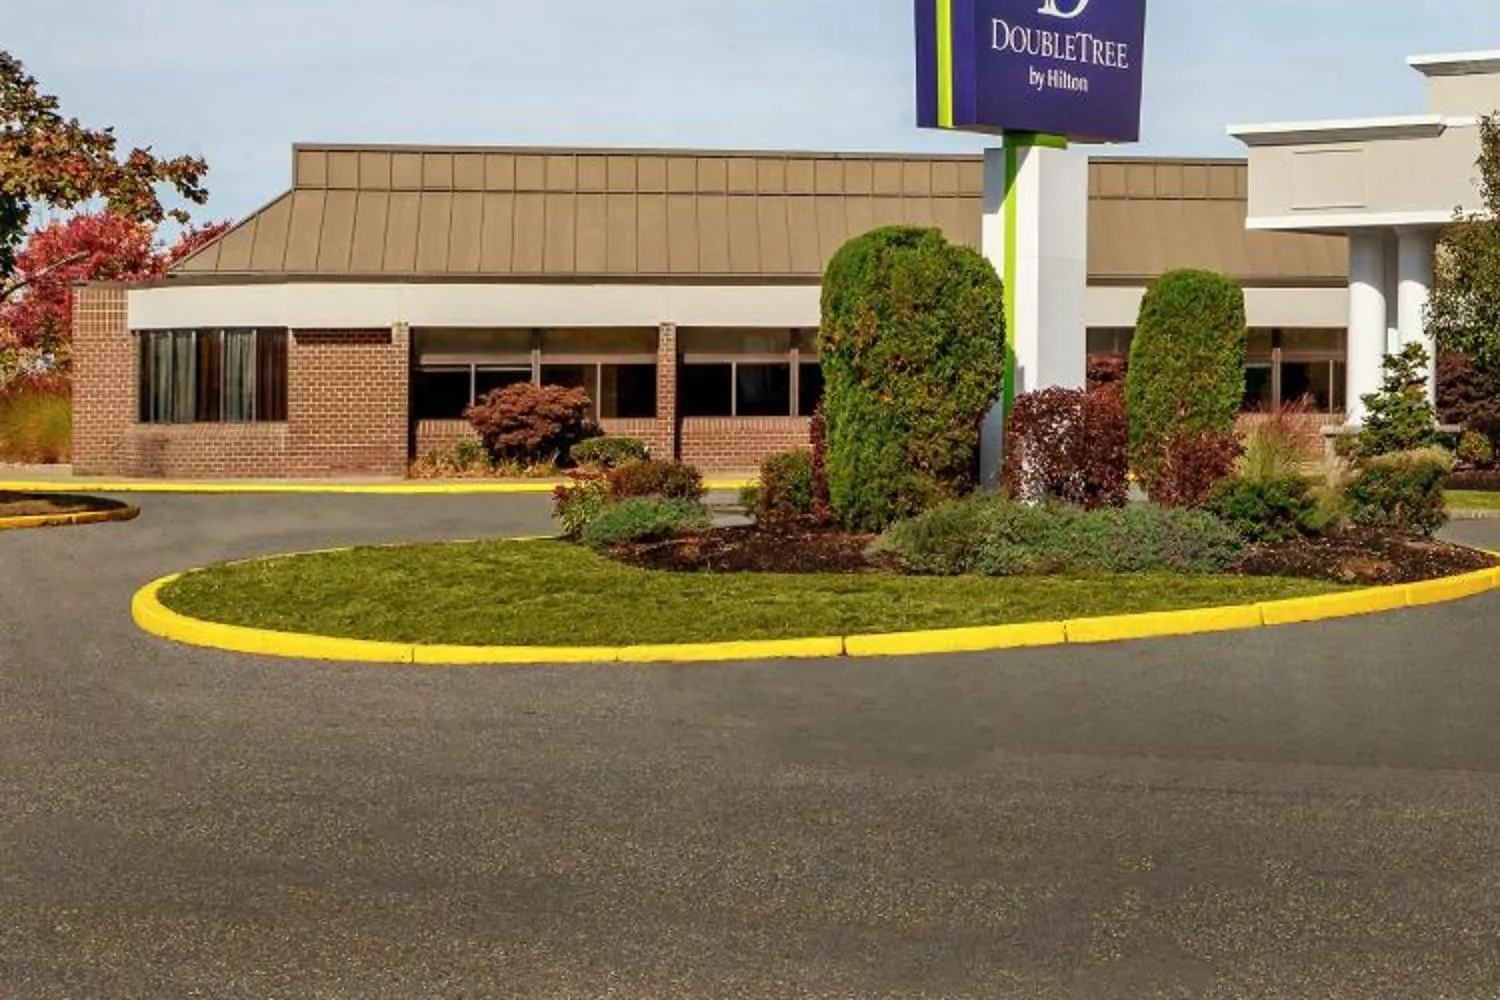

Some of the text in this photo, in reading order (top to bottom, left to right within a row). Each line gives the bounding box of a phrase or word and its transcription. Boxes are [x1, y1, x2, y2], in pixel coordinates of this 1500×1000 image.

[991, 18, 1129, 69] DOUBLETREE
[1028, 65, 1089, 92] by Hilton
